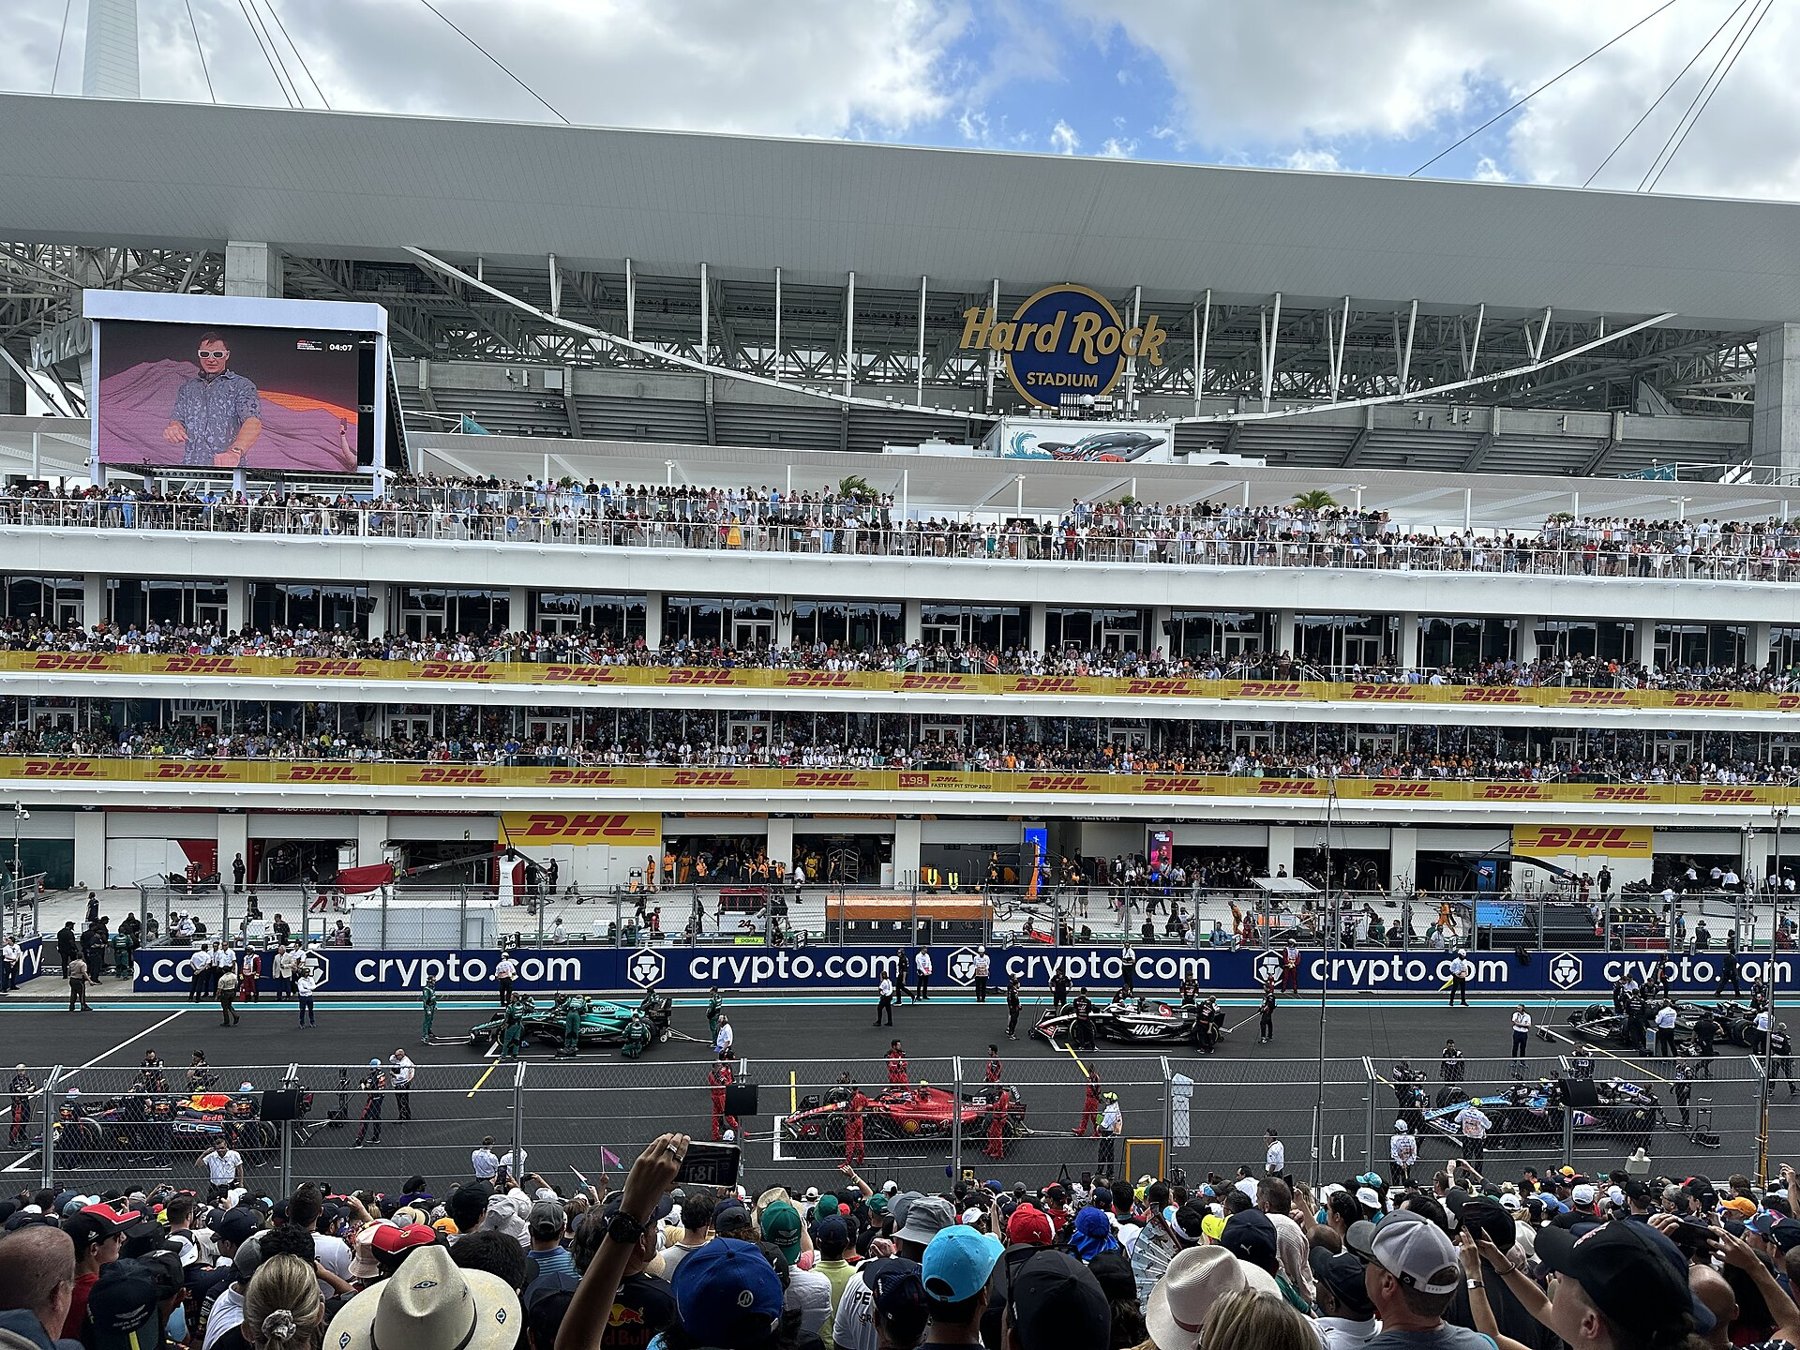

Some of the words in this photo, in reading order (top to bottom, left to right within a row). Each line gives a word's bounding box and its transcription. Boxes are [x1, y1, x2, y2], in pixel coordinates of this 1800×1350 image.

[959, 306, 1067, 353] Hard
[1068, 311, 1167, 367] Rock
[329, 343, 353, 352] 04:07
[1026, 371, 1098, 388] STADIUM
[34, 655, 109, 670] DHL
[165, 657, 239, 673] DHL
[293, 660, 366, 676] DHL
[420, 664, 494, 680] DHL
[544, 667, 615, 682] DHL
[667, 670, 736, 685] DHL
[785, 672, 852, 687] DHL
[900, 675, 966, 689] DHL
[1015, 678, 1080, 692] DHL
[1127, 680, 1192, 694] DHL
[1239, 683, 1303, 697] DHL
[1350, 685, 1416, 700] DHL
[1461, 688, 1523, 702] DHL
[1568, 690, 1631, 704] DHL
[1673, 693, 1735, 707] DHL
[24, 762, 94, 777] DHL
[157, 764, 233, 779] DHL
[289, 767, 358, 781] DHL
[418, 768, 488, 783] DHL
[548, 770, 614, 785] DHL
[672, 771, 738, 786] DHL
[794, 773, 859, 787] DHL
[1028, 776, 1090, 790] DHL
[1143, 778, 1203, 792] DHL
[1257, 781, 1318, 795] DHL
[1372, 783, 1433, 797] DHL
[1483, 786, 1542, 800] DHL
[1593, 787, 1652, 801] DHL
[1700, 789, 1757, 802] DHL
[525, 814, 635, 836] DHL
[1536, 827, 1630, 848] DHL
[506, 935, 516, 943] 14
[689, 951, 900, 984] crypto.com
[1128, 1024, 1166, 1035] HAAS
[972, 1097, 986, 1105] 55
[172, 1123, 205, 1132] ACLE
